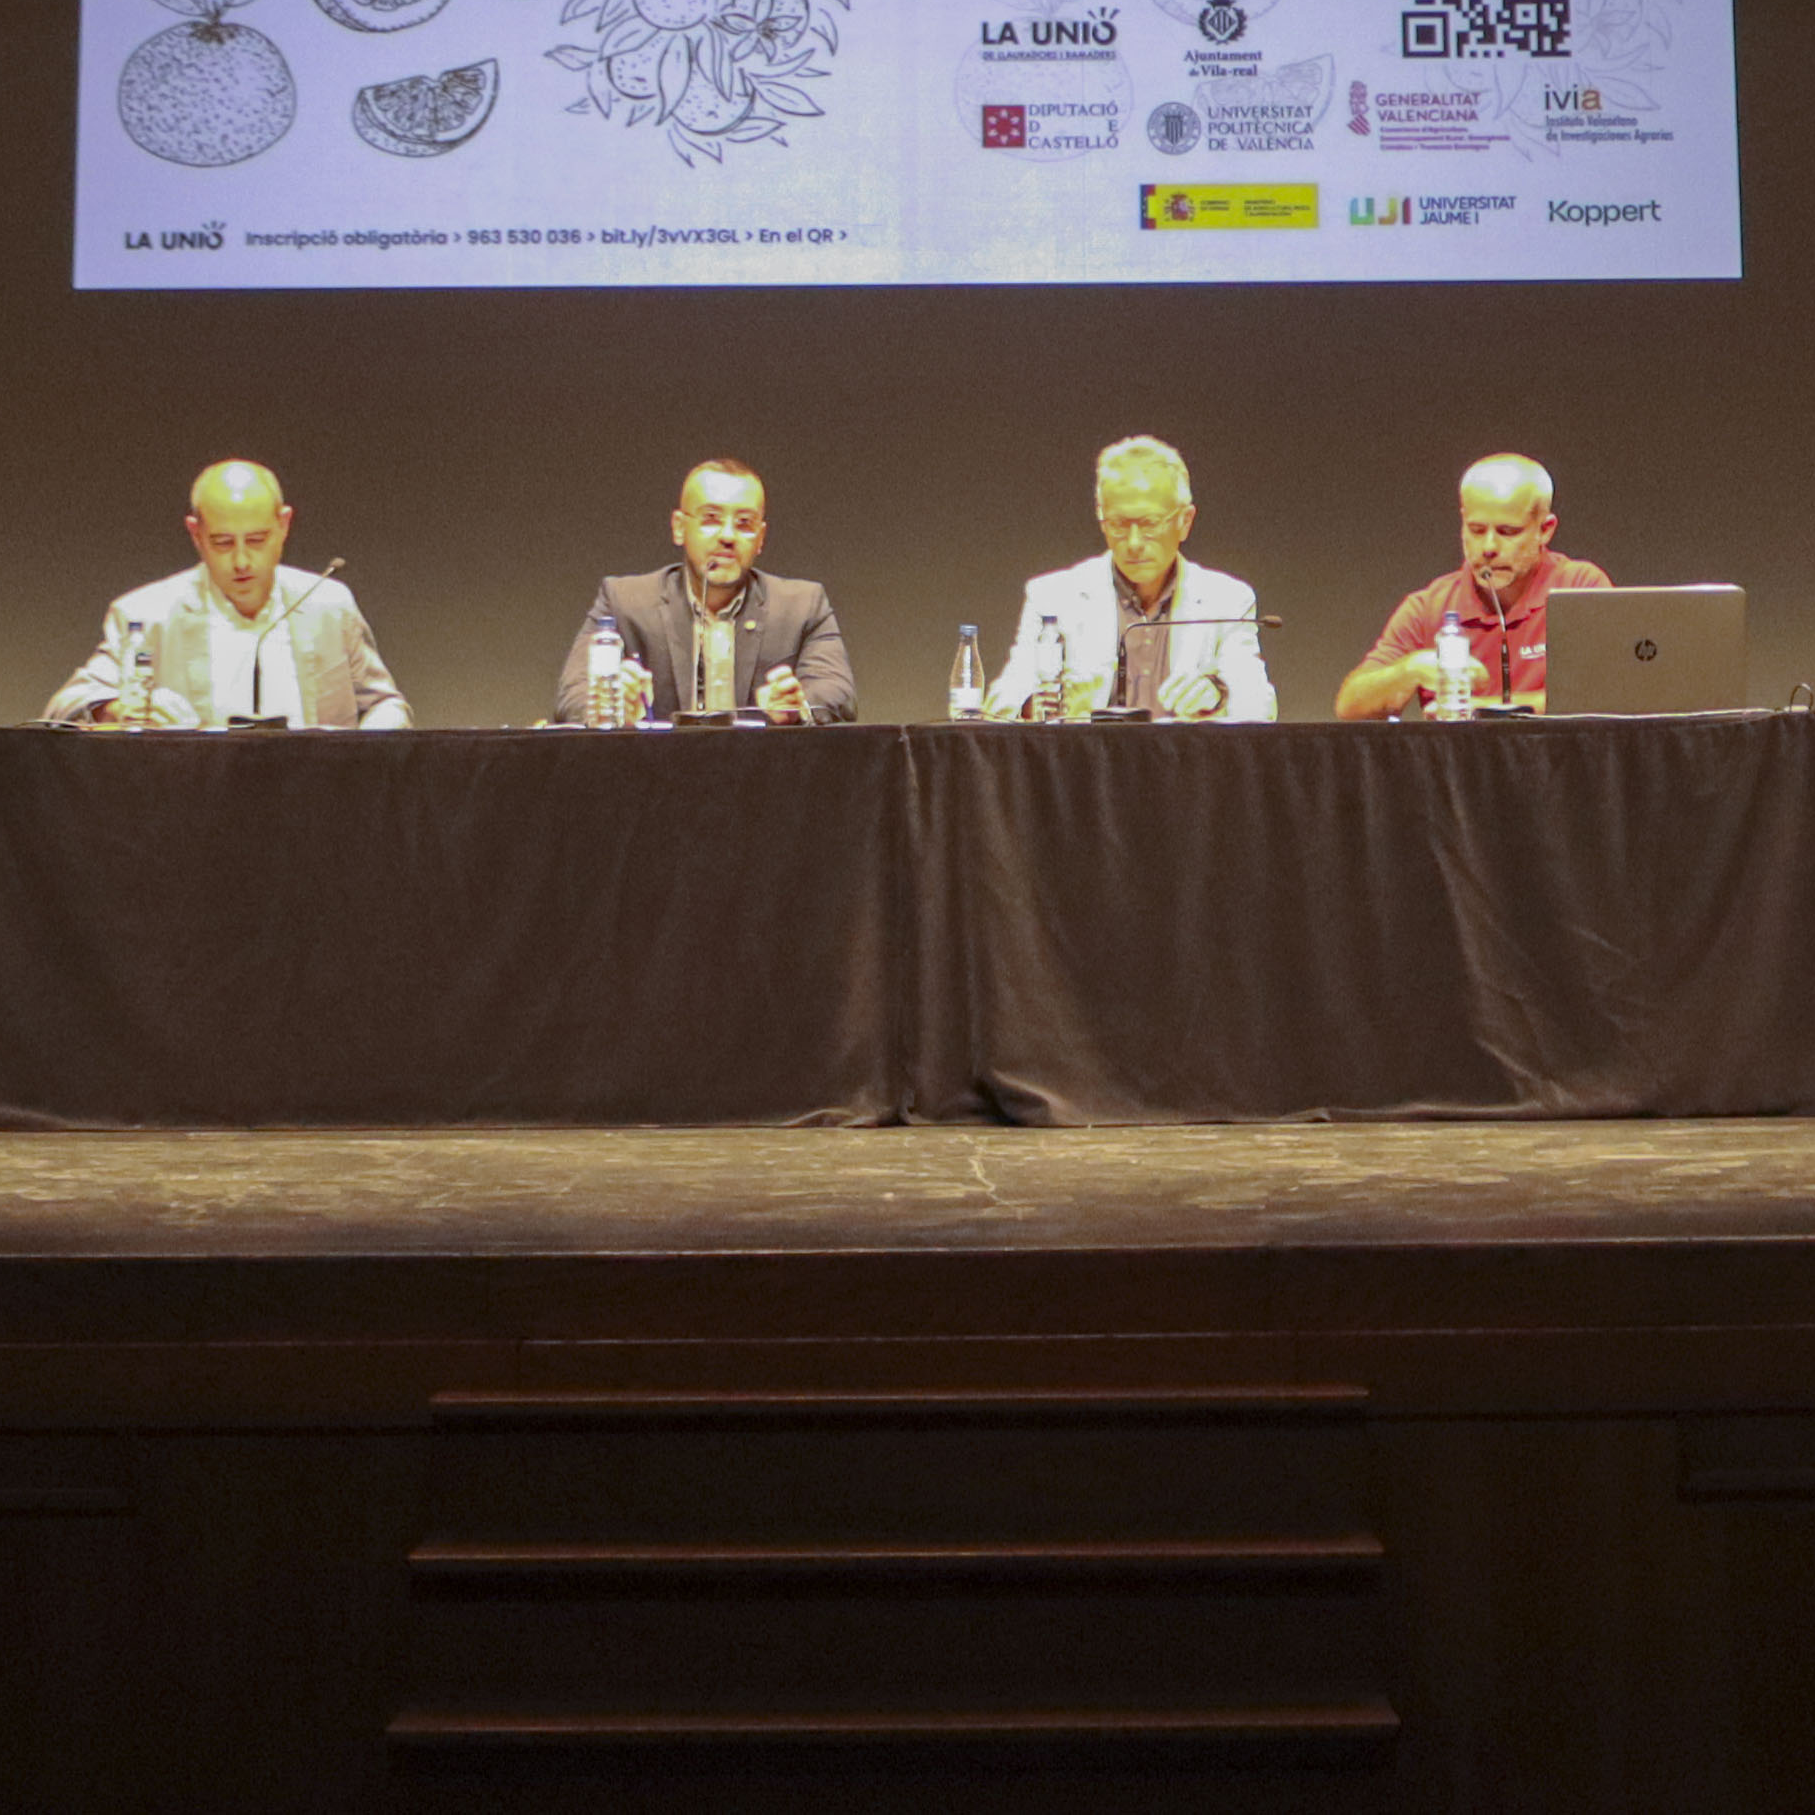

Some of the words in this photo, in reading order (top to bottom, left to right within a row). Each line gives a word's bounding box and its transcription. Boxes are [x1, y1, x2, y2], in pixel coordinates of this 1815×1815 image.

[981, 21, 1019, 46] LA
[1183, 49, 1263, 64] Ajuntament
[1201, 64, 1258, 77] Vila-real
[1375, 92, 1481, 107] GENERALITAT
[1544, 83, 1602, 111] ivia
[1028, 100, 1119, 118] DIPUTACIÓ
[1207, 105, 1313, 120] UNIVERSITAT
[1377, 108, 1479, 123] VALENCIANA
[1028, 132, 1119, 149] CASTELLÓ
[1418, 195, 1517, 211] UNIVERSITAT
[1419, 211, 1472, 226] JAUME
[1548, 199, 1662, 227] Koppert
[124, 231, 153, 251] LA
[244, 229, 340, 251] Inscripció
[466, 229, 502, 246] 963
[506, 228, 543, 245] 530
[545, 228, 582, 245] 036
[758, 228, 781, 244] En
[806, 228, 834, 246] QR
